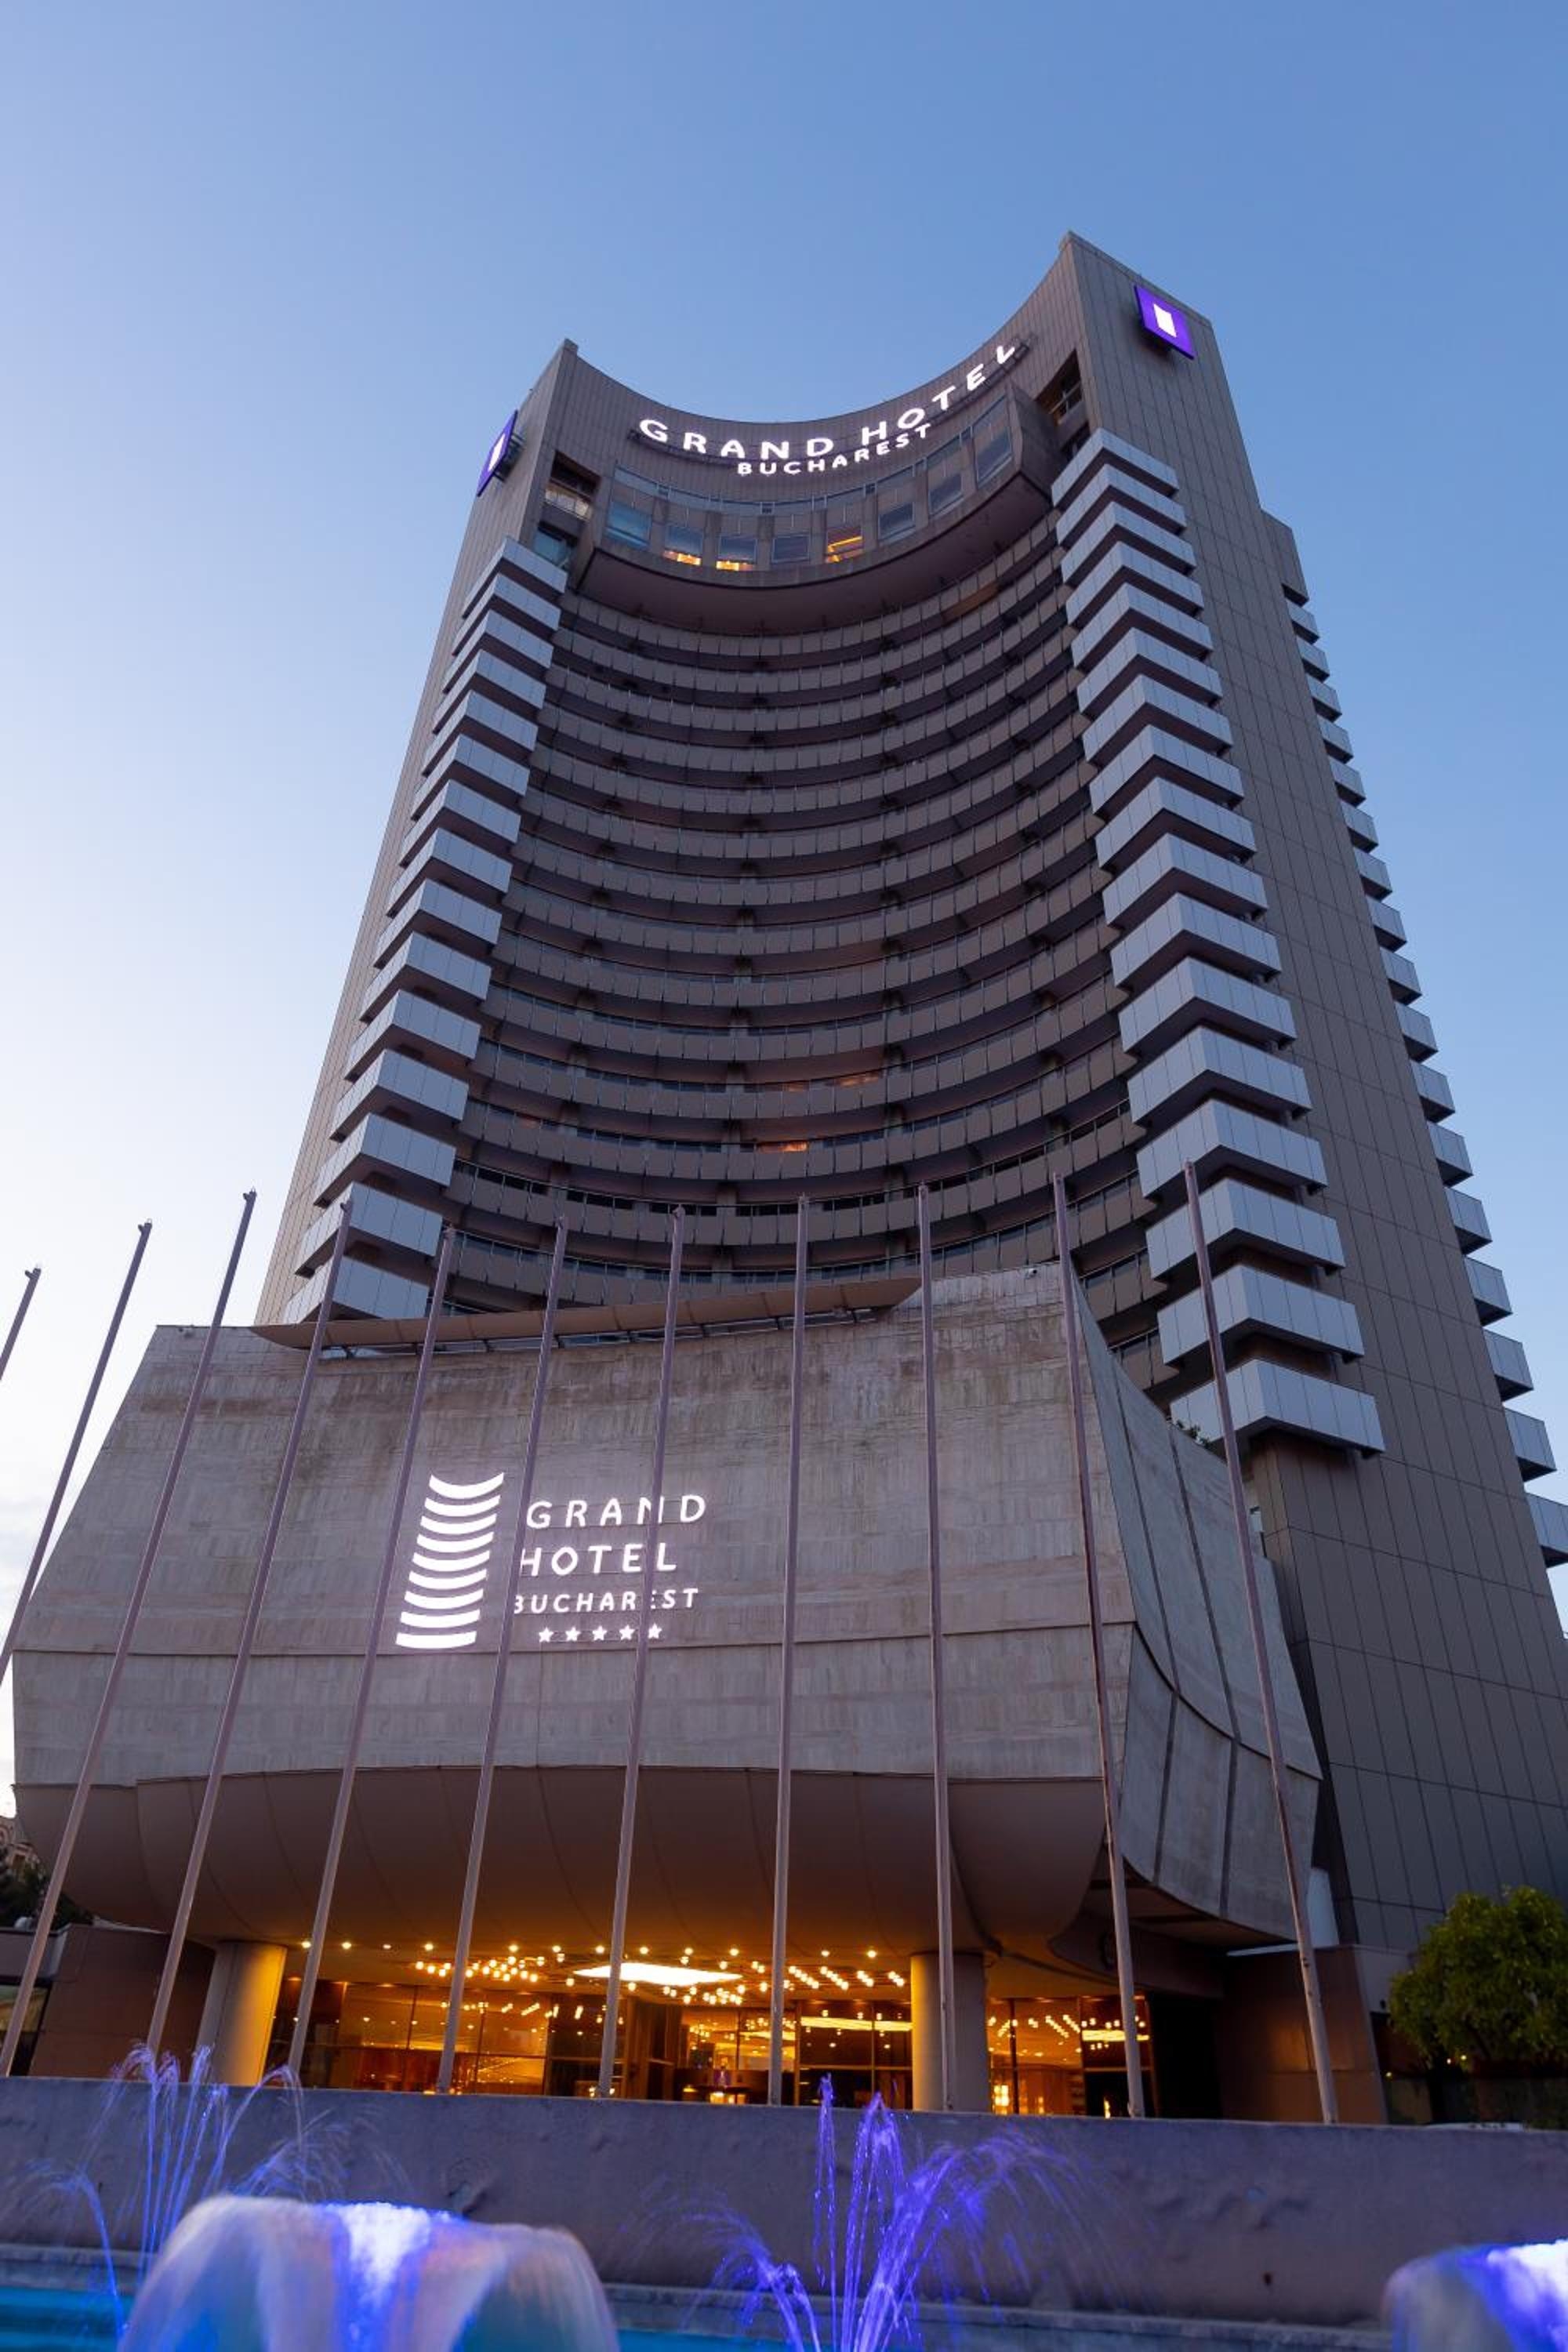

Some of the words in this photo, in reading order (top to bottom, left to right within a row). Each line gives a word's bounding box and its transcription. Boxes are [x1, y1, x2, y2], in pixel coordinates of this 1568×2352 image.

[639, 419, 835, 460] GRAND
[861, 345, 1016, 447] HOTEL
[737, 422, 932, 476] BUCHAREST
[526, 1494, 706, 1530] GRAND
[520, 1541, 677, 1577] HOTEL
